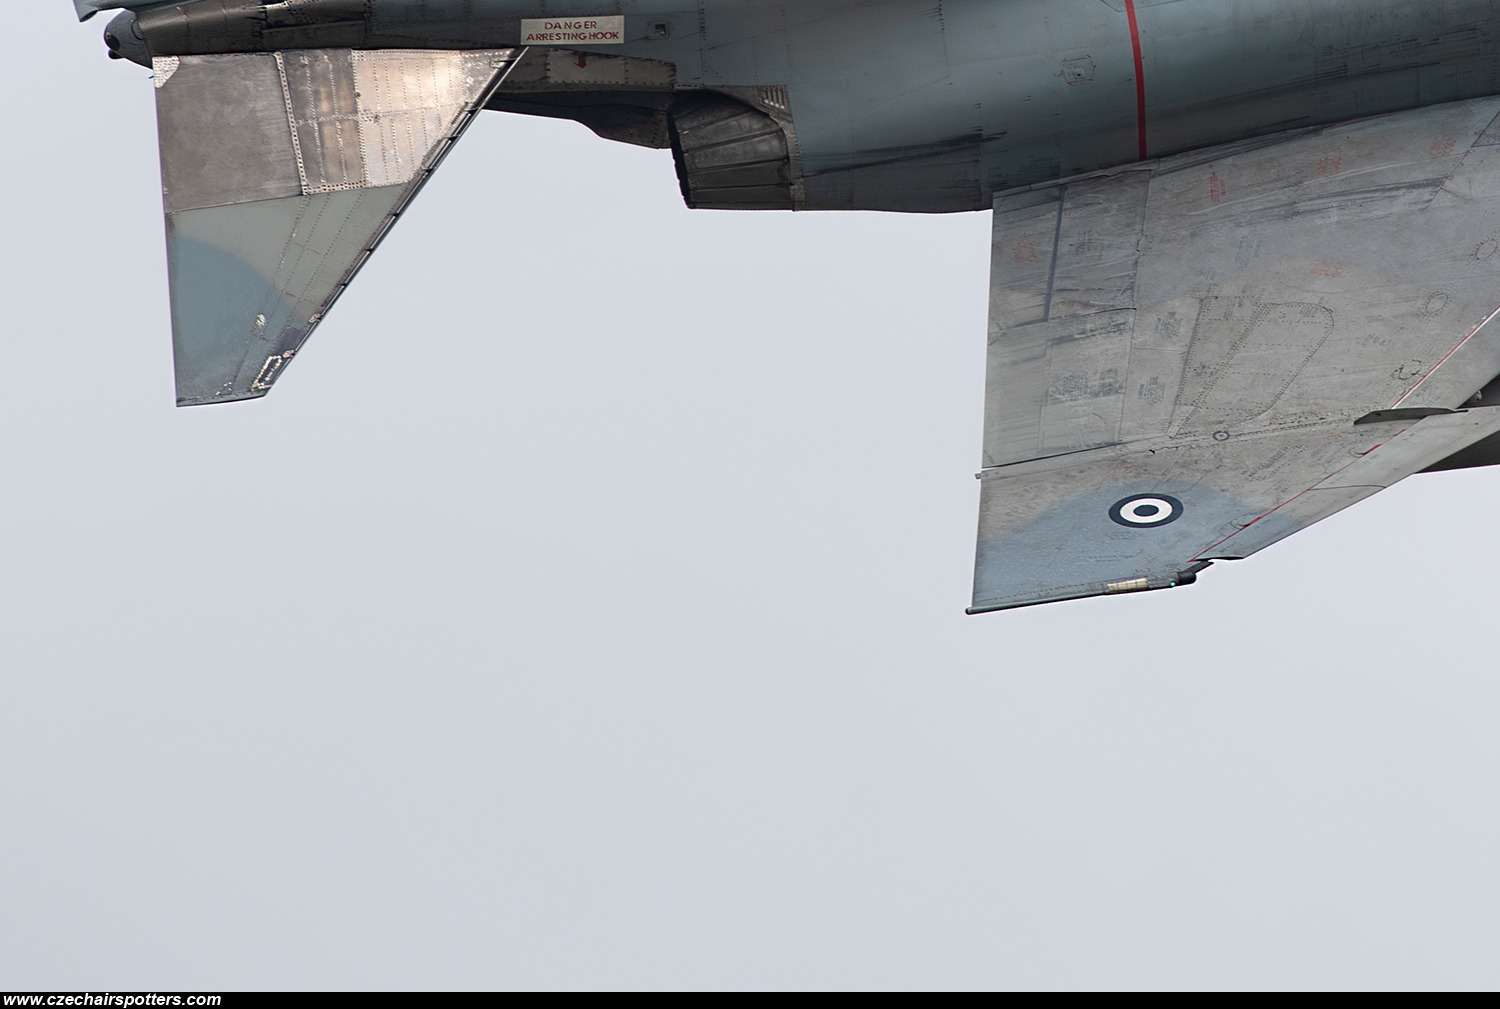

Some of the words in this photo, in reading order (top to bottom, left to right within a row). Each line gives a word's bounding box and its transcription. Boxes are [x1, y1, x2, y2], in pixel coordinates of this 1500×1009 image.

[544, 20, 598, 30] DANGER
[526, 32, 587, 41] ARRESTING
[588, 31, 620, 40] HOOK
